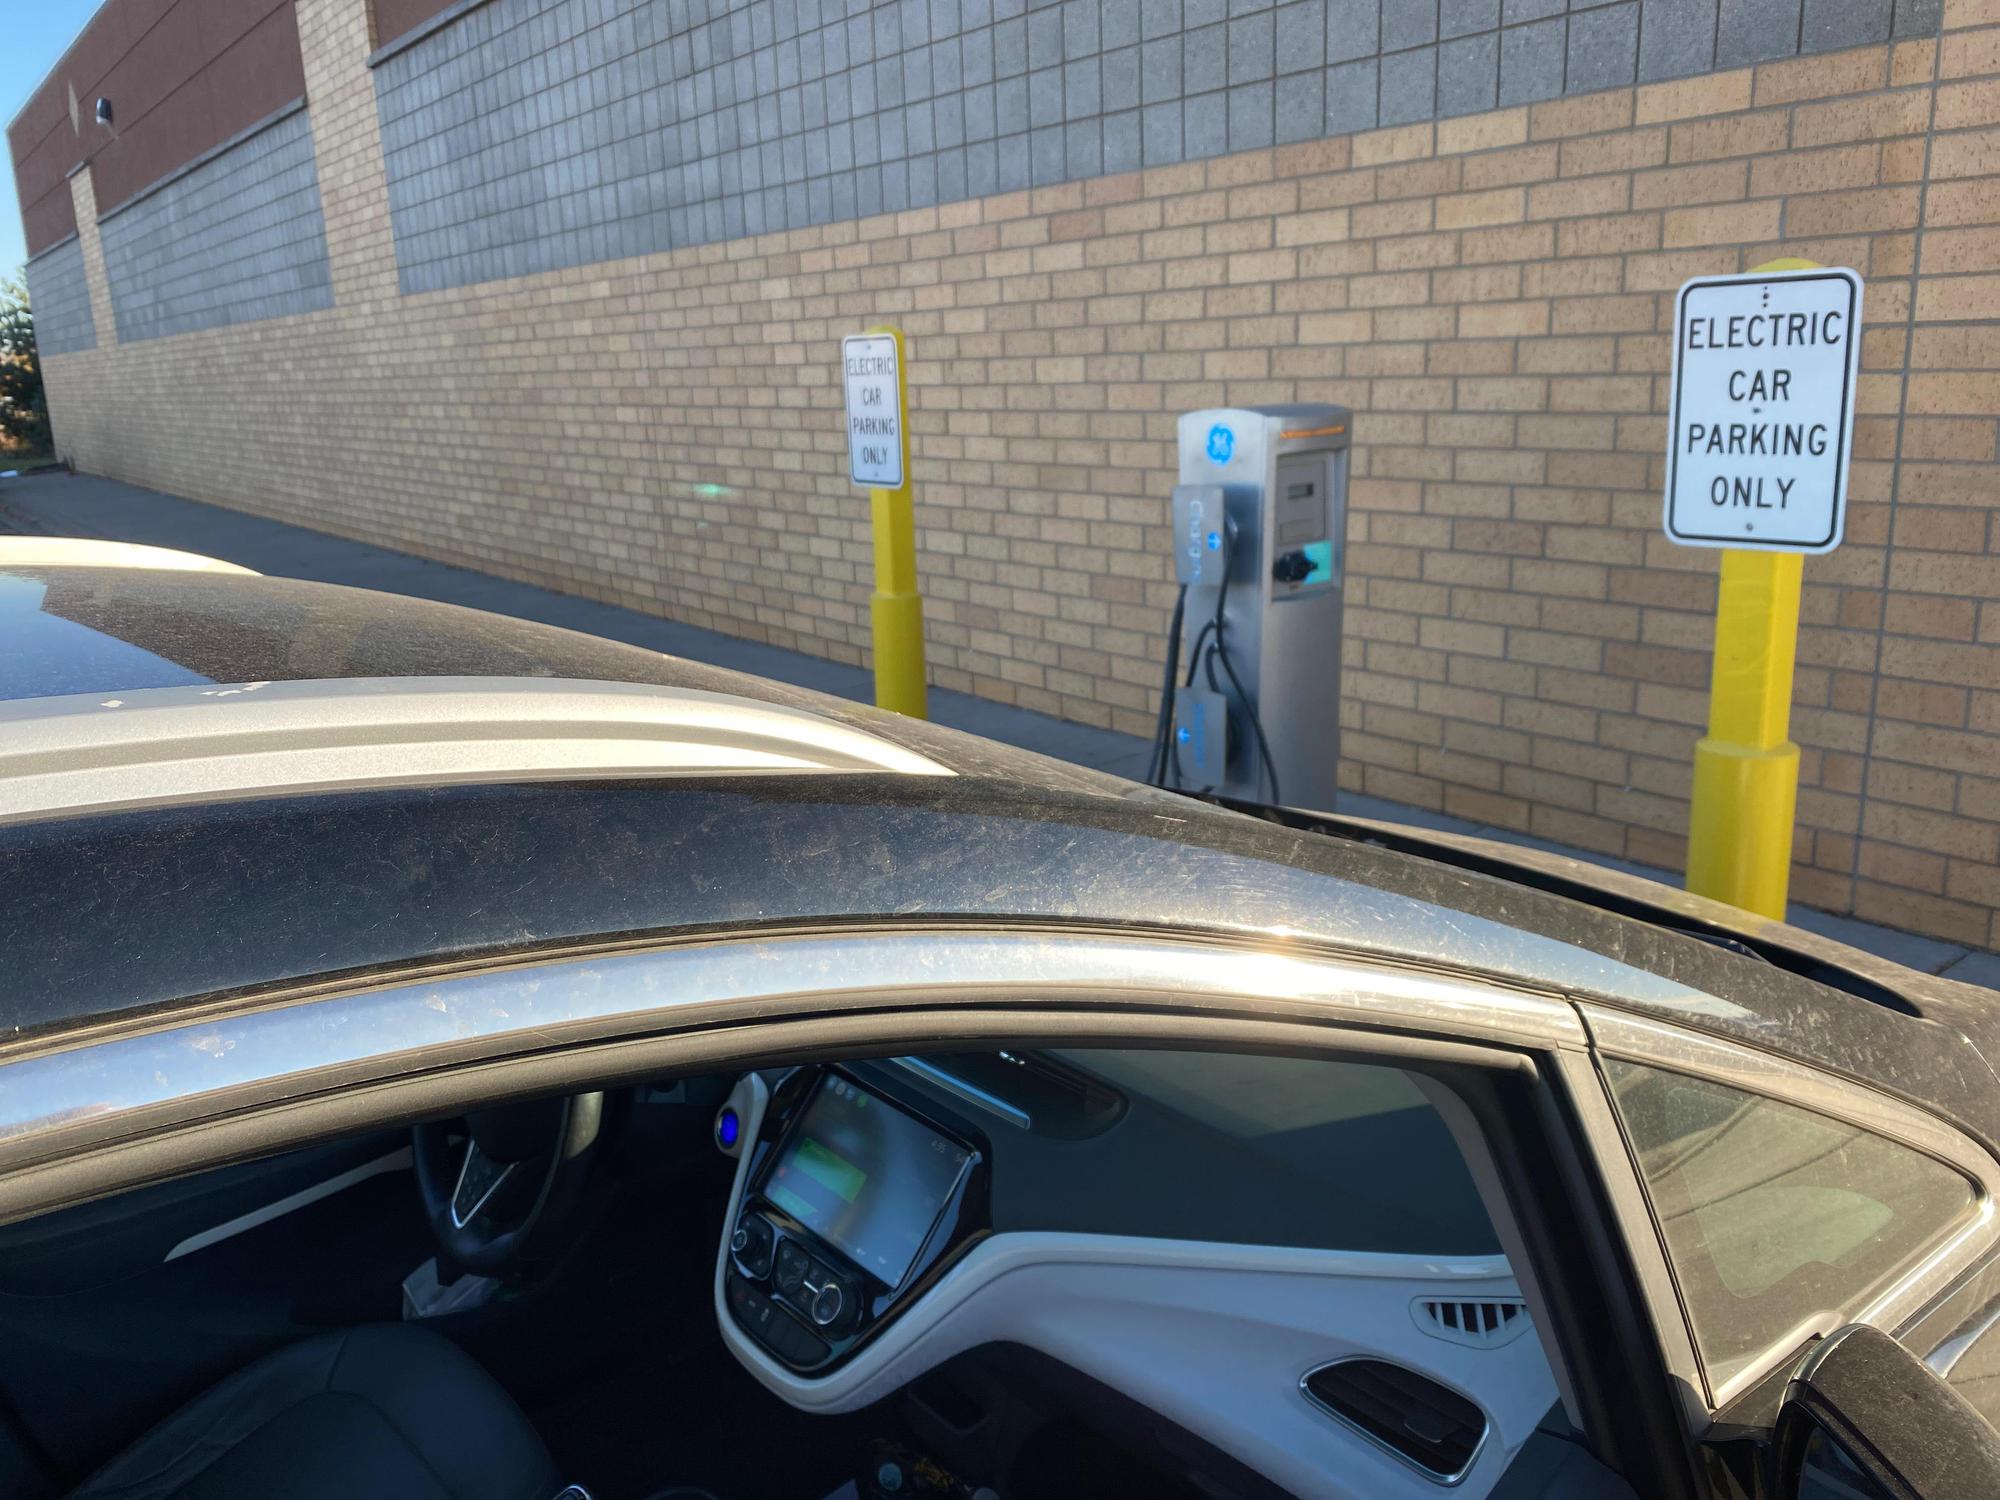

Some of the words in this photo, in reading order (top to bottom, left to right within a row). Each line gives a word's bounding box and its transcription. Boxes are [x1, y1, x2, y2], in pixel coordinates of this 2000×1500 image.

[1689, 311, 1843, 349] ELECTRIC
[848, 357, 894, 376] ELECTRIC
[862, 388, 881, 406] CAR
[1729, 369, 1792, 401] CAR
[853, 417, 895, 436] PARKING
[1688, 424, 1828, 456] PARKING
[862, 447, 888, 465] ONLY
[1711, 476, 1796, 509] ONLY
